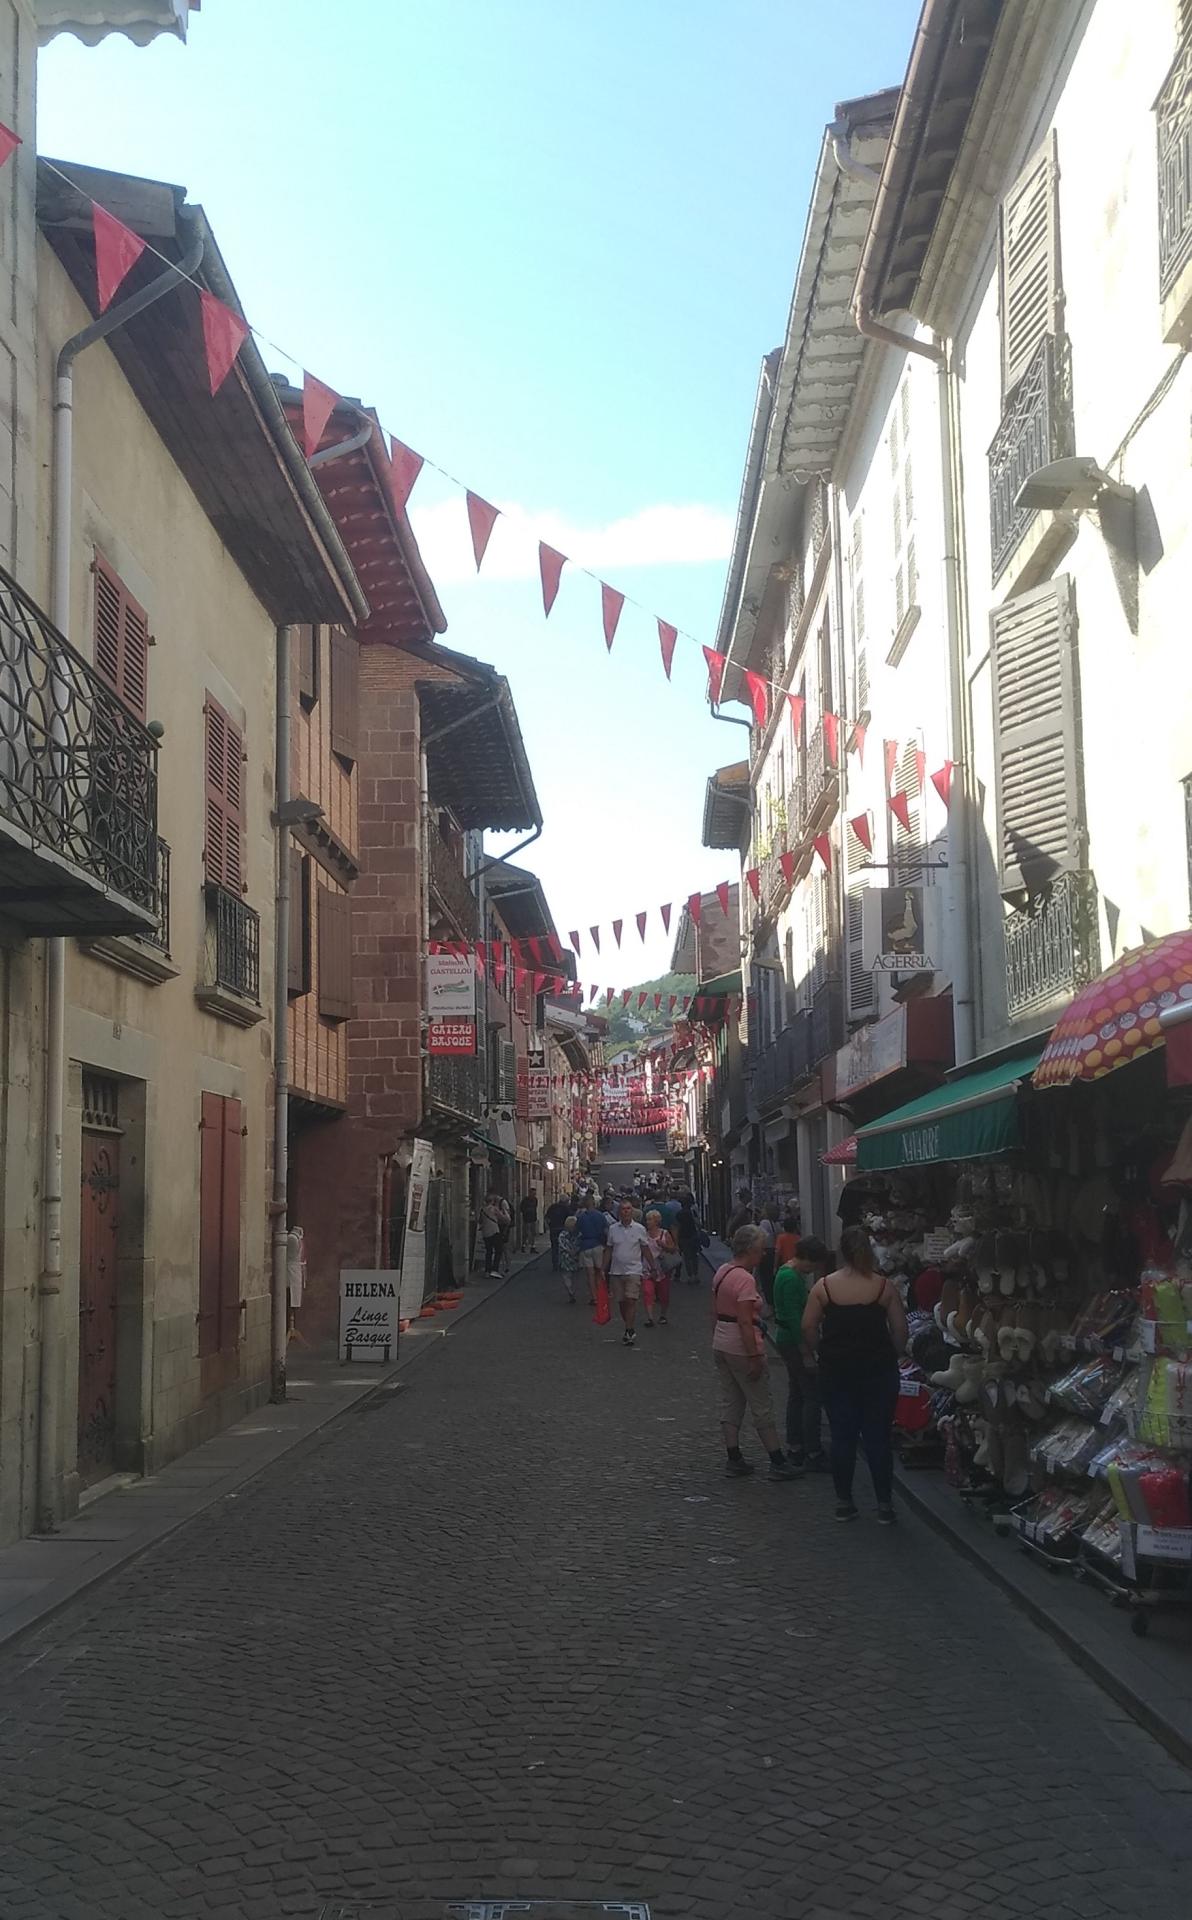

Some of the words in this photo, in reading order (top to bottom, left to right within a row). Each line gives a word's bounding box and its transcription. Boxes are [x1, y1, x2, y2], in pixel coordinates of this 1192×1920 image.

[871, 954, 936, 969] AGERRIA
[431, 1024, 472, 1035] GATEAU
[431, 1036, 472, 1047] BASQUE
[901, 1124, 940, 1163] NAVARRE
[345, 1282, 396, 1298] HELENA
[350, 1306, 388, 1328] Linge
[345, 1327, 392, 1348] Basque
